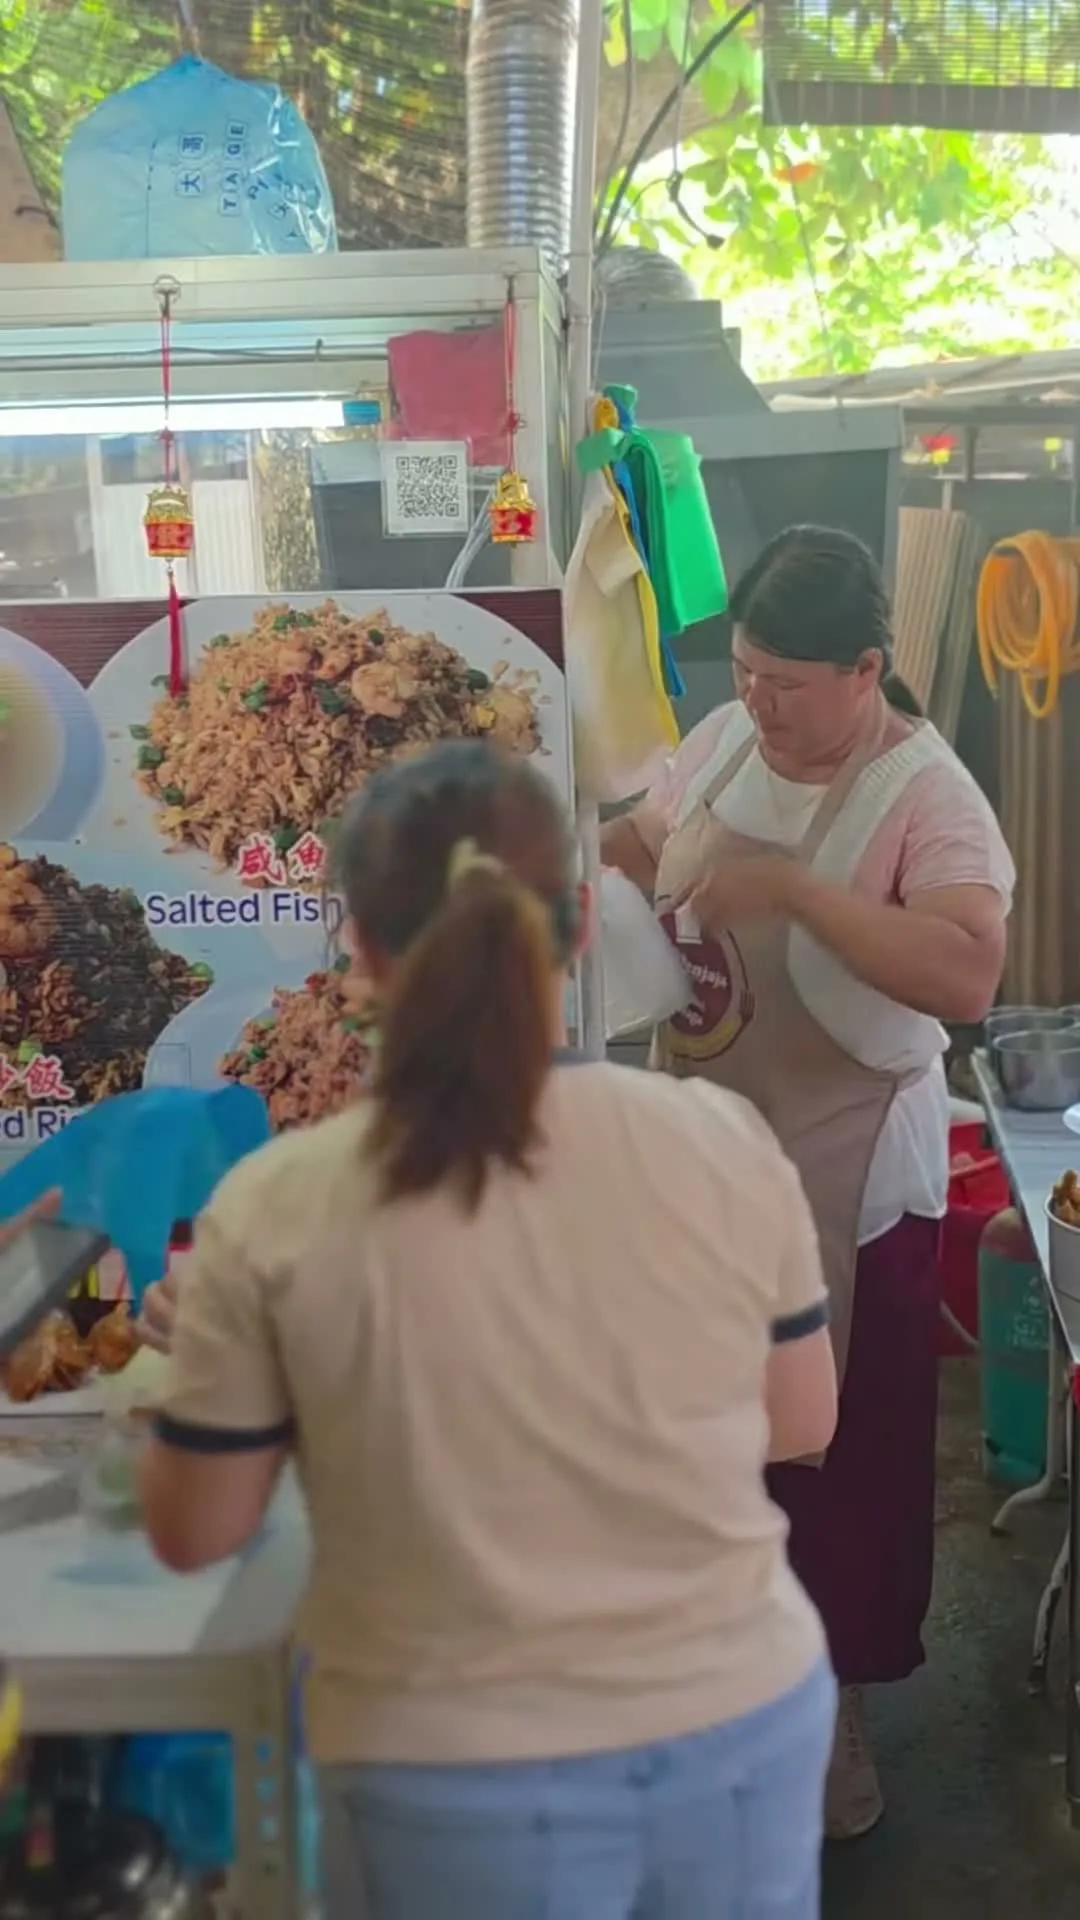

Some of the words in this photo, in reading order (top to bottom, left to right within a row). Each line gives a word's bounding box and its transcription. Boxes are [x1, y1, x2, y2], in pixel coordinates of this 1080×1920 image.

[146, 893, 260, 925] Salted
[0, 1110, 25, 1138] d
[37, 1110, 80, 1138] Ri
